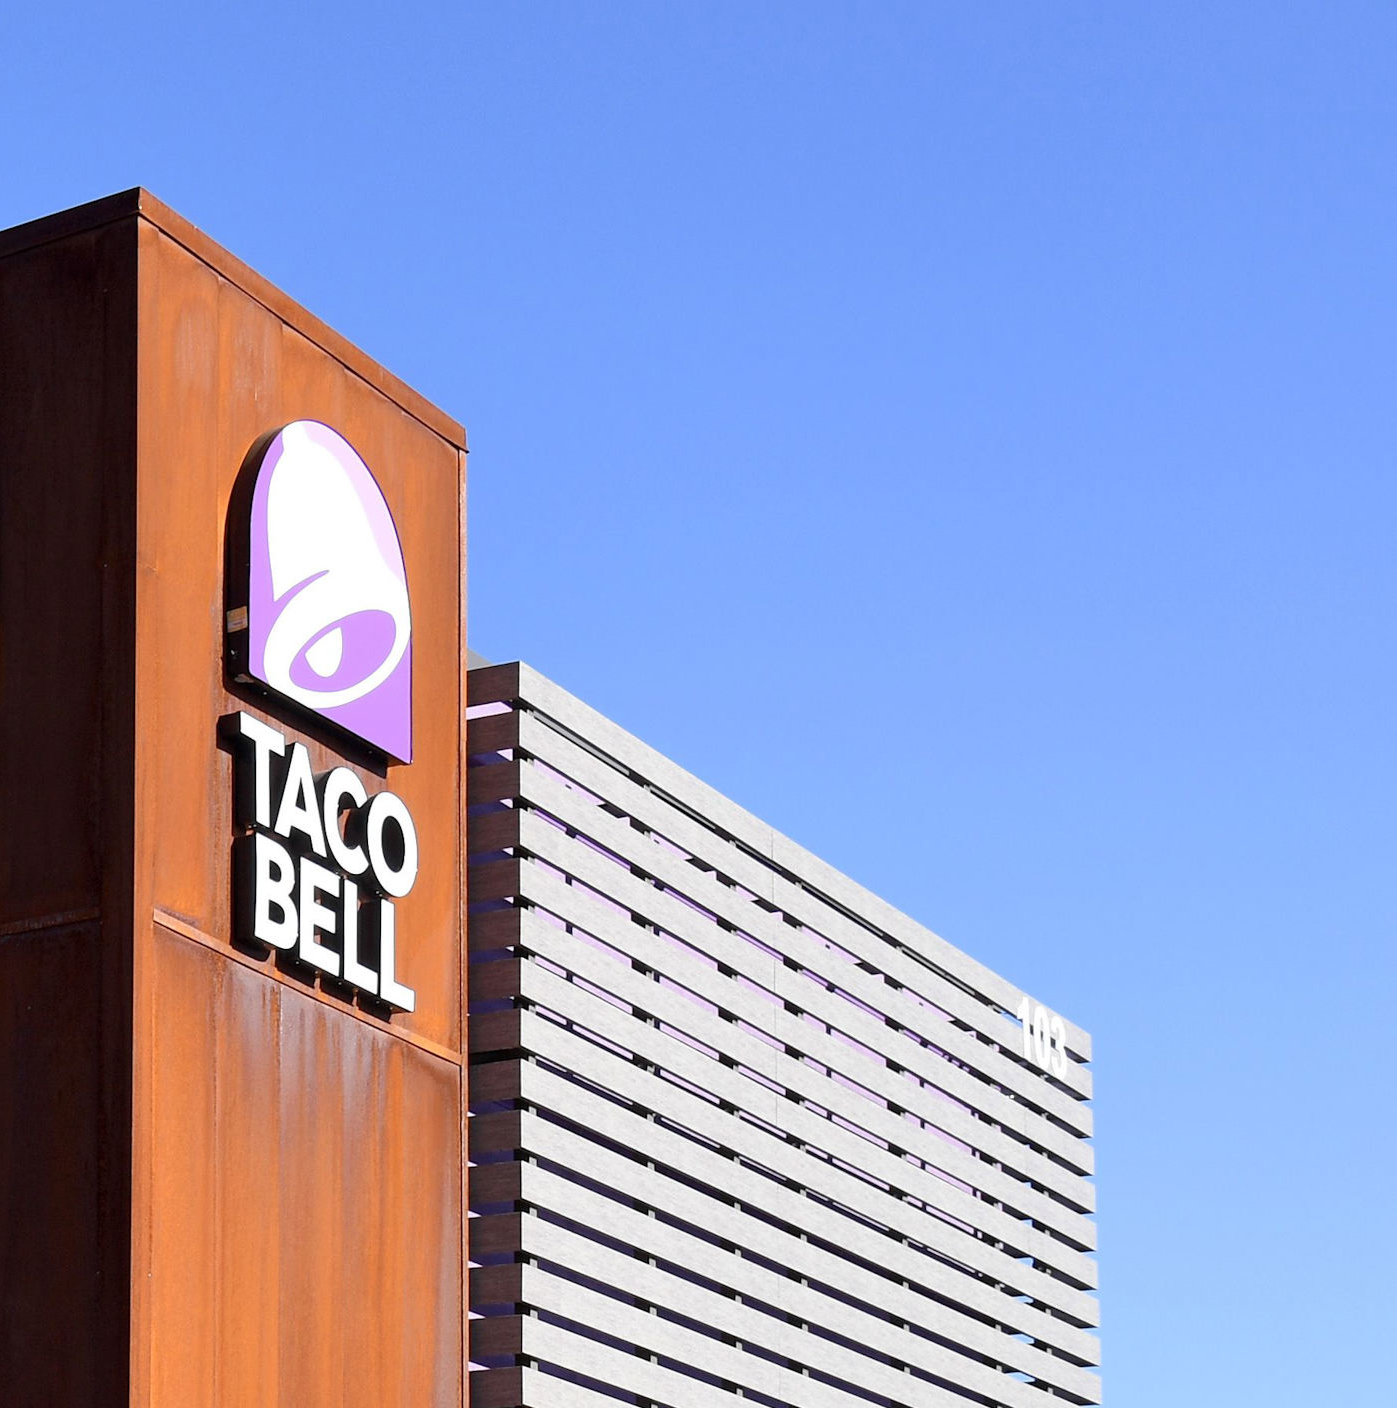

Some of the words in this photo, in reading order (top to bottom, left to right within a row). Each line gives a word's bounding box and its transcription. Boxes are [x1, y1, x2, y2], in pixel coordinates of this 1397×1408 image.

[238, 711, 419, 898] TACO
[251, 833, 415, 1012] BELL
[1017, 996, 1068, 1080] 103
